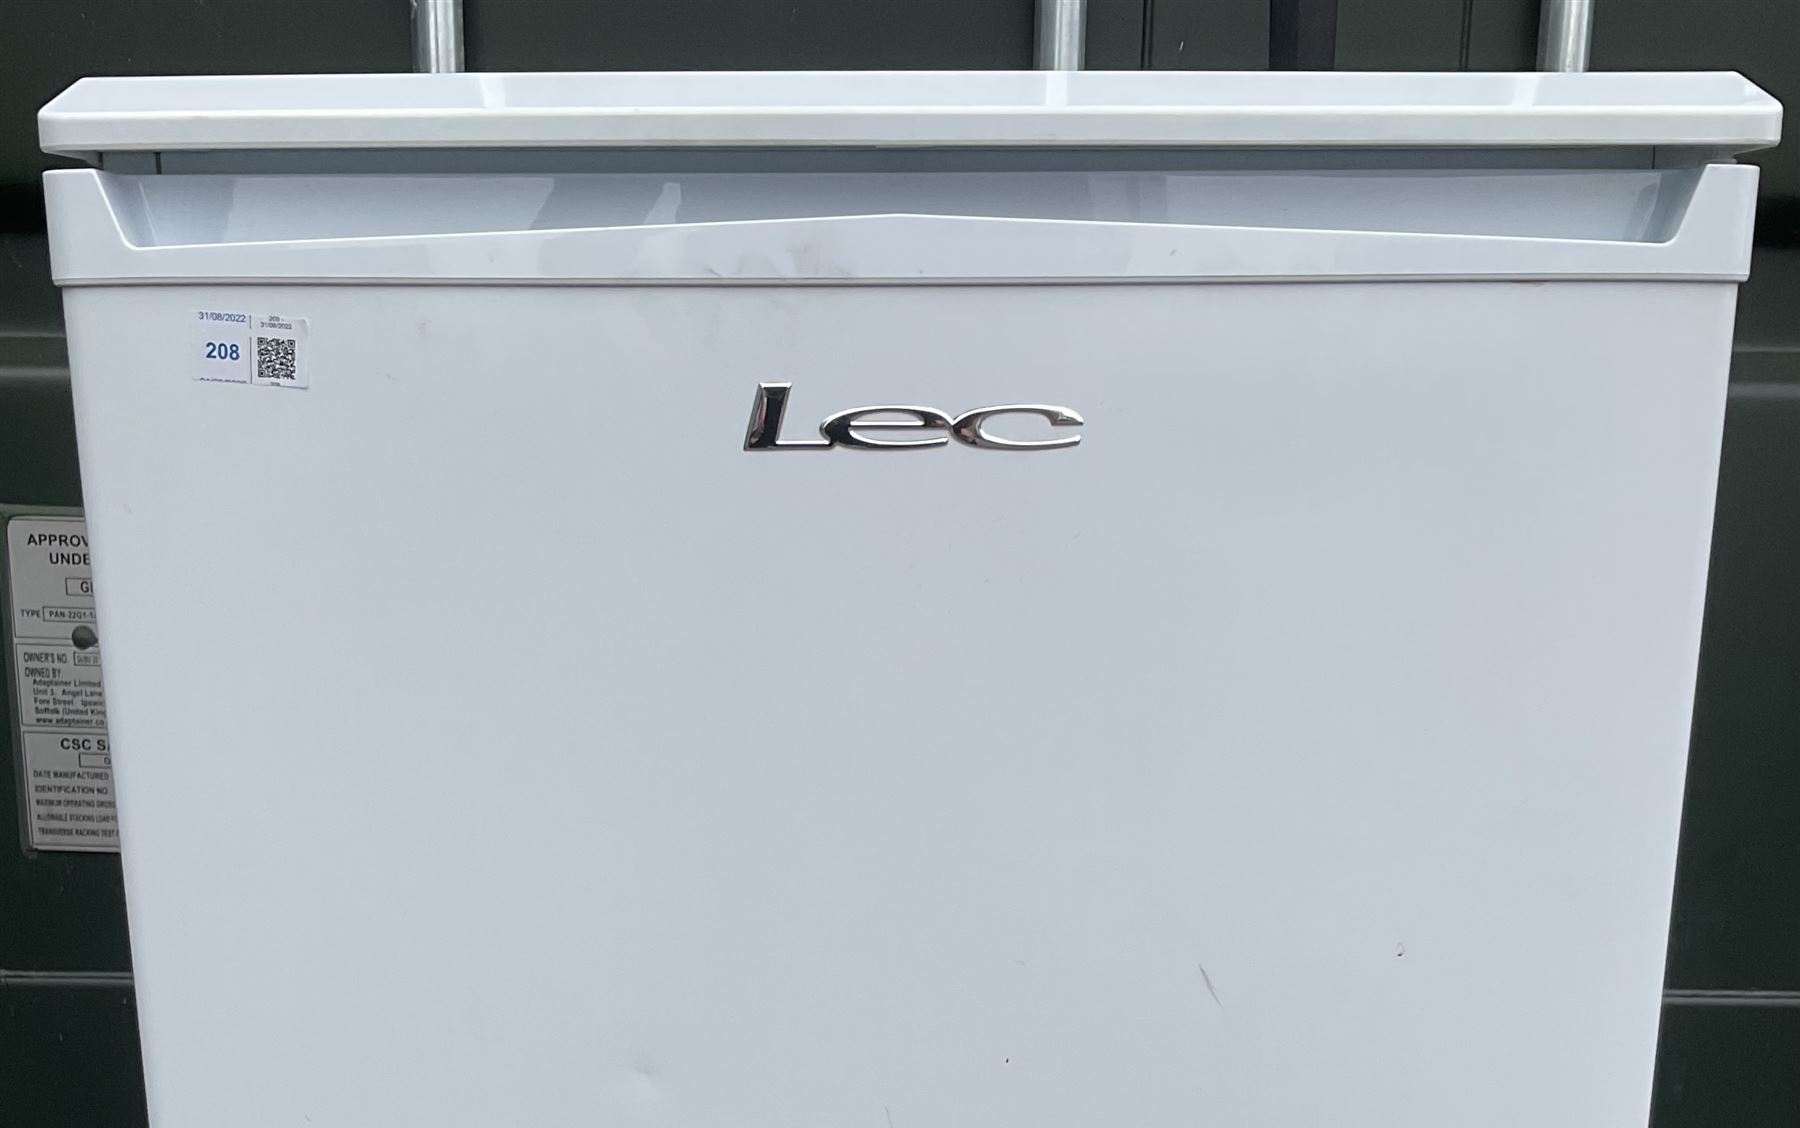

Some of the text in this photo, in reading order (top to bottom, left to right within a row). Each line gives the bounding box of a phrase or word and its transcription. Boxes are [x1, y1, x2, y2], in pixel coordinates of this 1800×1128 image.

[198, 311, 246, 323] 31/08/2022
[206, 342, 240, 361] 208
[744, 382, 1084, 451] Lec
[80, 581, 94, 594] G
[21, 608, 41, 618] TYPE
[25, 667, 62, 679] OWNED BY
[74, 680, 102, 688] Limited
[62, 689, 83, 698] Angel
[85, 690, 103, 698] Lane
[35, 707, 60, 715] Suffolk
[60, 738, 110, 751] CSC S
[33, 770, 110, 781] DATE MANUFACTURED
[34, 785, 95, 795] IDENTIFICATION
[63, 800, 95, 808] OPERATING
[69, 814, 95, 823] STACKING
[75, 829, 101, 837] RACKING
